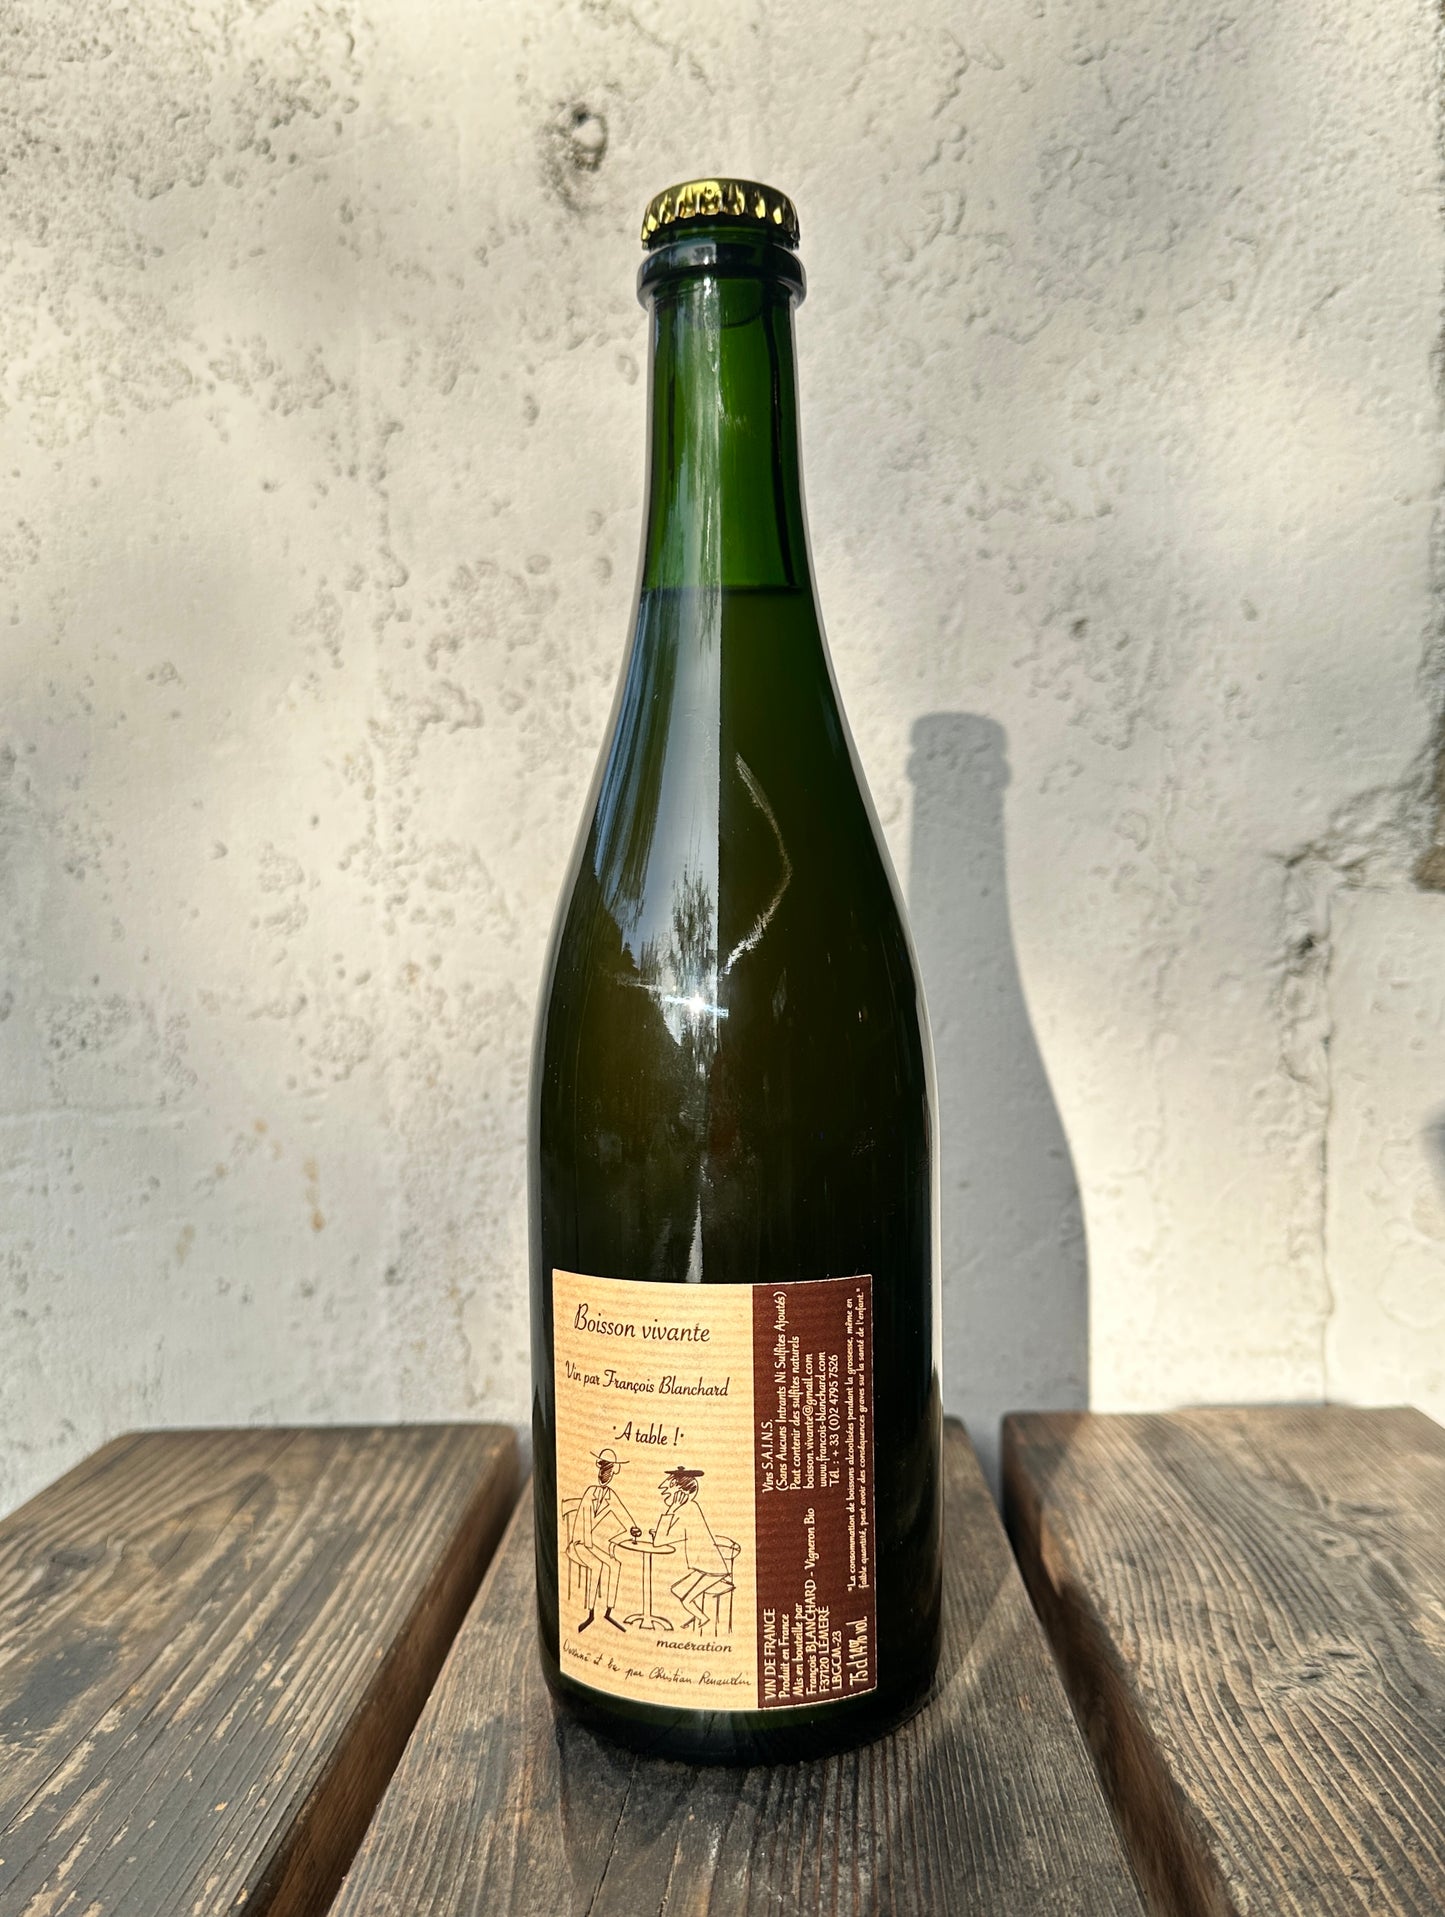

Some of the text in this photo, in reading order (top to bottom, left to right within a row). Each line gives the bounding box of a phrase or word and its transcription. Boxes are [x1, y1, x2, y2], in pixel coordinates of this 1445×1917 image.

[847, 1299, 852, 1308] en
[574, 1303, 710, 1342] Boisson vivante
[845, 1311, 853, 1334] même
[856, 1328, 864, 1337] de
[846, 1337, 856, 1374] grossesse,
[856, 1340, 864, 1361] santé
[566, 1360, 730, 1396] Vin par François Blanchard
[828, 1355, 838, 1378] 7526
[855, 1363, 864, 1371] la
[774, 1291, 790, 1491] (Sans Aucuns Intrants Ni Sulfites Ajoutés)
[829, 1381, 839, 1405] 4795
[844, 1387, 856, 1420] pendant
[858, 1388, 868, 1412] graves
[788, 1336, 804, 1490] Peut contenir des sulfites naturels
[802, 1354, 817, 1489] boisson.vivante@gmail.com
[815, 1352, 830, 1487] www.francois-blanchard.com
[828, 1408, 840, 1430] (0)2
[635, 1423, 668, 1445] table
[829, 1434, 839, 1446] 33
[845, 1423, 854, 1465] alcoolisées
[857, 1415, 868, 1467] conséquences
[761, 1419, 774, 1493] Vins S.A.I.N.S.
[846, 1467, 855, 1500] boissons
[857, 1470, 866, 1483] des
[804, 1508, 815, 1524] Bio
[846, 1502, 855, 1512] de
[859, 1508, 869, 1525] peut
[804, 1527, 819, 1569] Vigneron
[848, 1515, 856, 1573] consommation
[858, 1566, 870, 1588] faible
[805, 1580, 816, 1652] BLANCHARD
[656, 1639, 732, 1653] macération
[764, 1608, 776, 1699] VIN DE FRANCE
[778, 1614, 790, 1698] Produit en France
[792, 1603, 806, 1696] Mis en bouteille par
[832, 1631, 842, 1689] LBGCM-23
[849, 1635, 868, 1659] 14%
[625, 1668, 644, 1680] par
[650, 1667, 691, 1684] Christian
[806, 1655, 818, 1695] François
[819, 1657, 830, 1691] F37120
[846, 1658, 868, 1668] cl
[850, 1671, 868, 1686] 75
